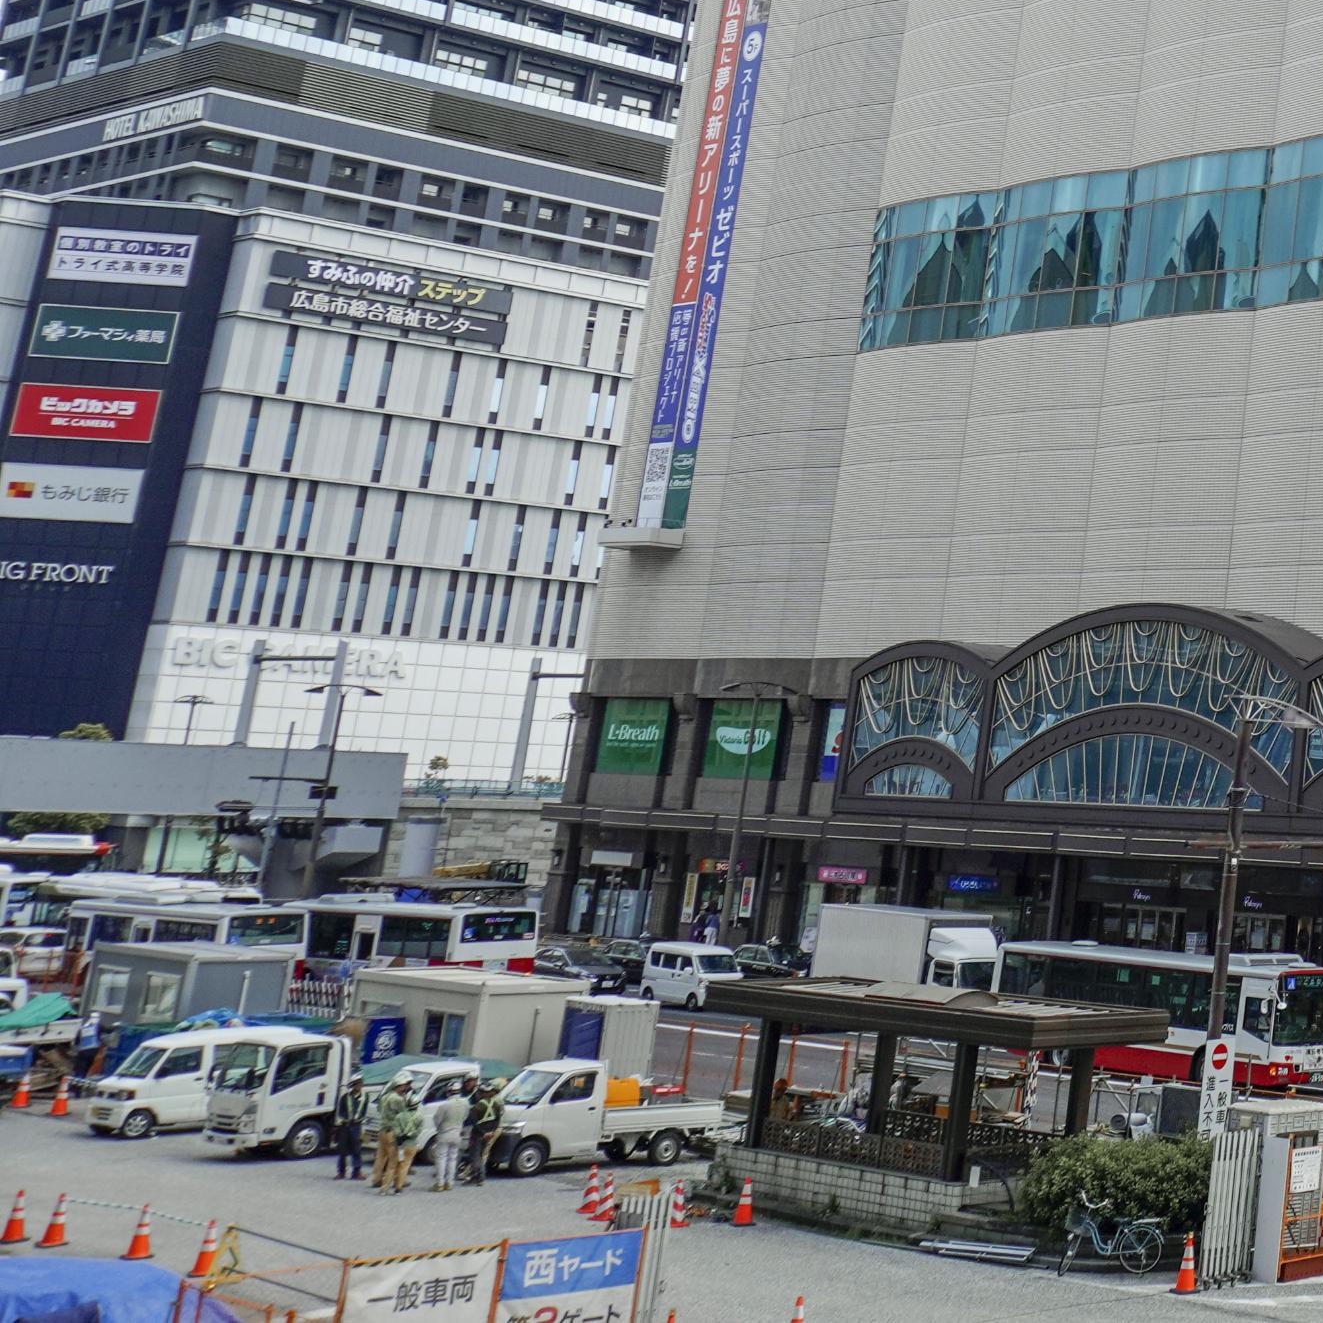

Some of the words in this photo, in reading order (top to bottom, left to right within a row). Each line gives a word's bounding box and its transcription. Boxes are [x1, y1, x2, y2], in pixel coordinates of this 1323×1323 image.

[103, 114, 137, 141] HOTEL
[137, 97, 204, 133] KAWASHIMA
[59, 236, 190, 257] 個別教室のトライ
[706, 206, 735, 284] ゼビオ
[58, 257, 186, 276] トライ式高等学院
[307, 259, 415, 295] すみふの仲介
[418, 279, 486, 305] ステップ
[290, 291, 487, 334] 広島市総合福祉センター
[39, 396, 136, 415] ビックカメラ
[71, 418, 116, 429] CAMERA
[41, 485, 130, 504] もみじ銀行
[29, 562, 114, 584] FRONT
[172, 636, 242, 668] BIC
[523, 1248, 624, 1288] 西ヤード
[367, 1274, 478, 1312] 一般車両
